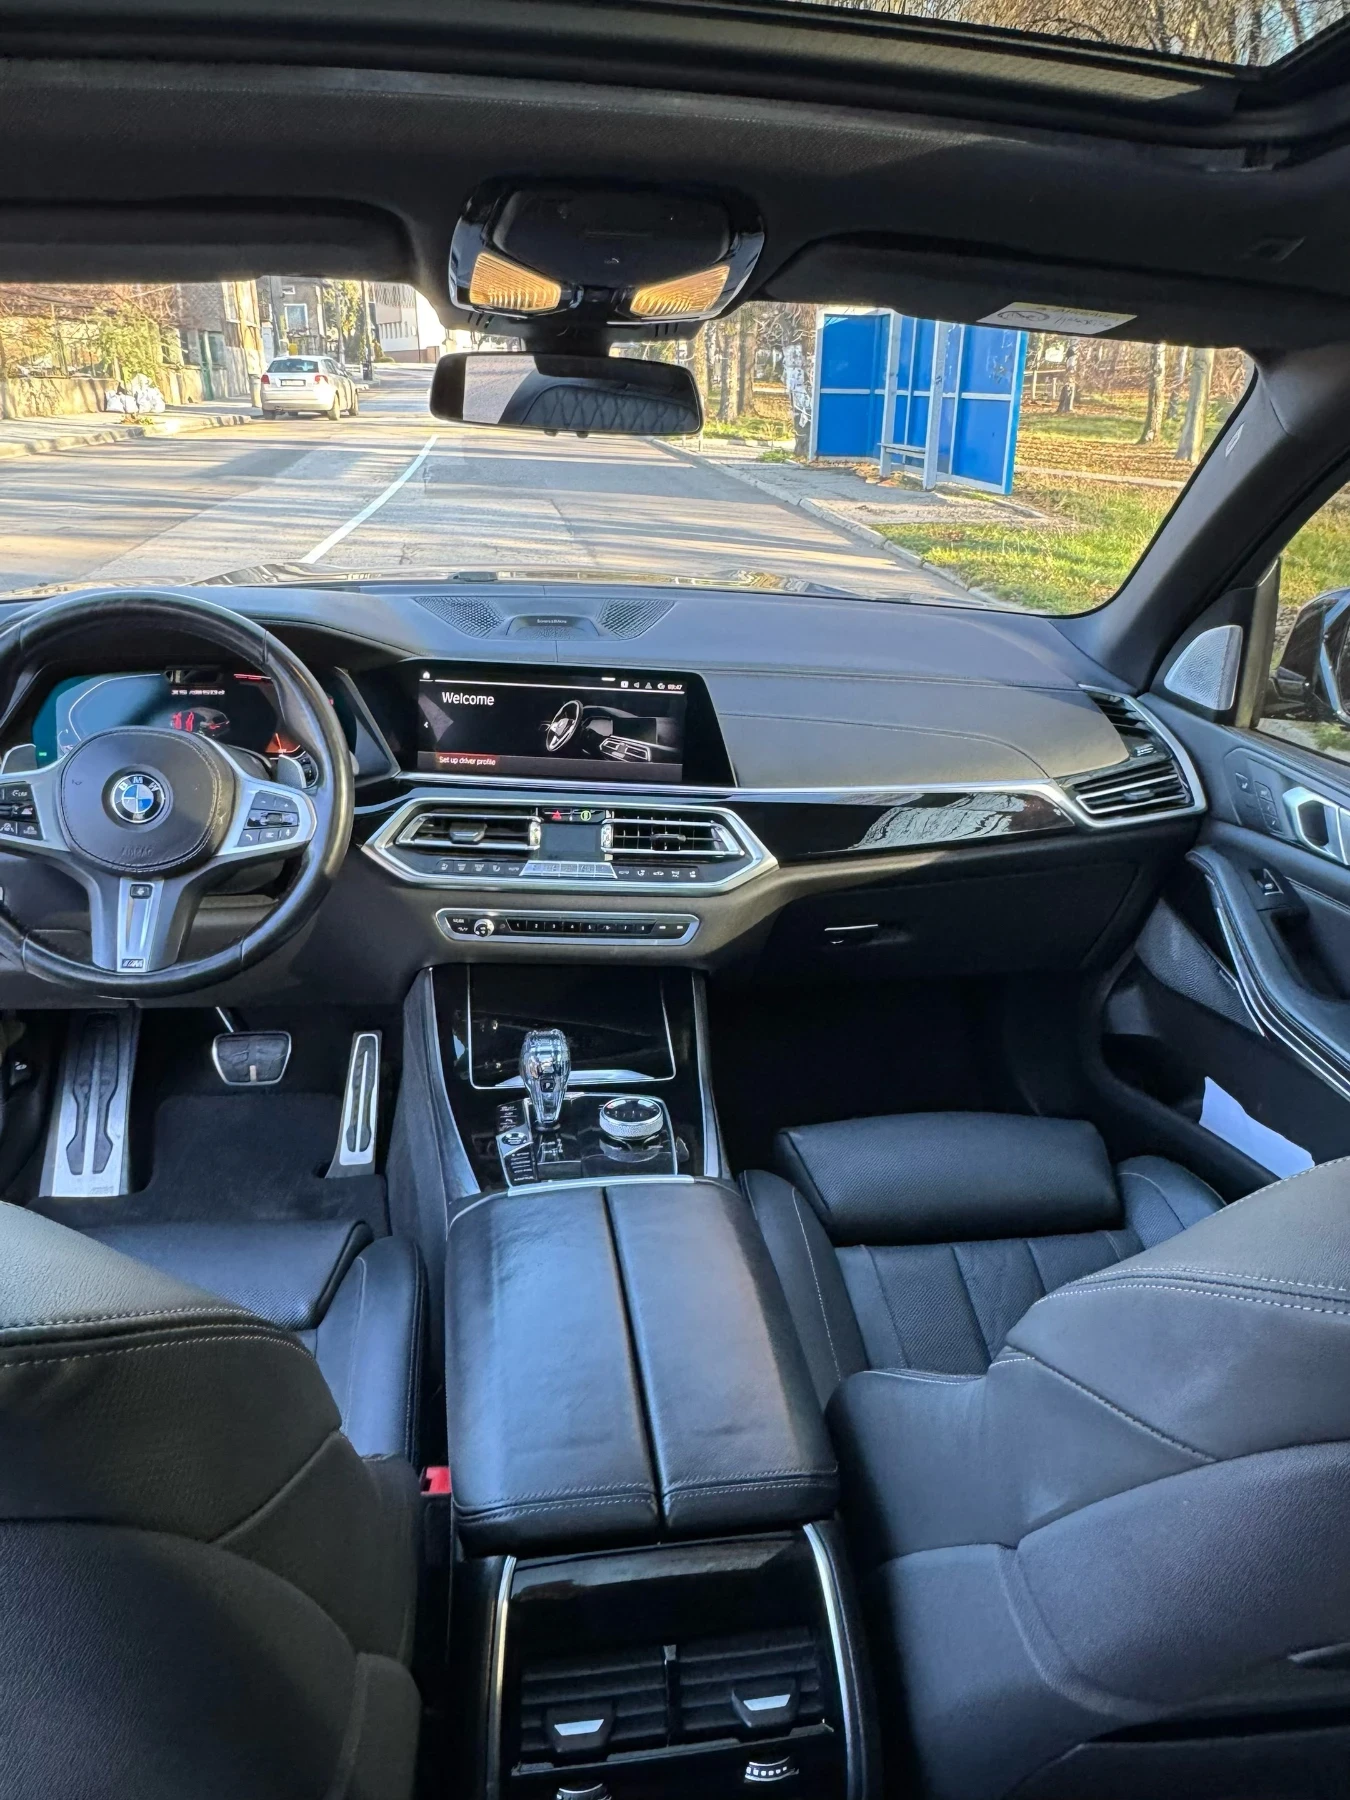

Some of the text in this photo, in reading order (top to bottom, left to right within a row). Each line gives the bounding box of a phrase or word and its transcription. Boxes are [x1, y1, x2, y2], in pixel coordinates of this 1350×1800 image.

[441, 691, 495, 706] Welcome
[439, 756, 496, 766] Set up driver profile
[119, 776, 160, 791] BMW
